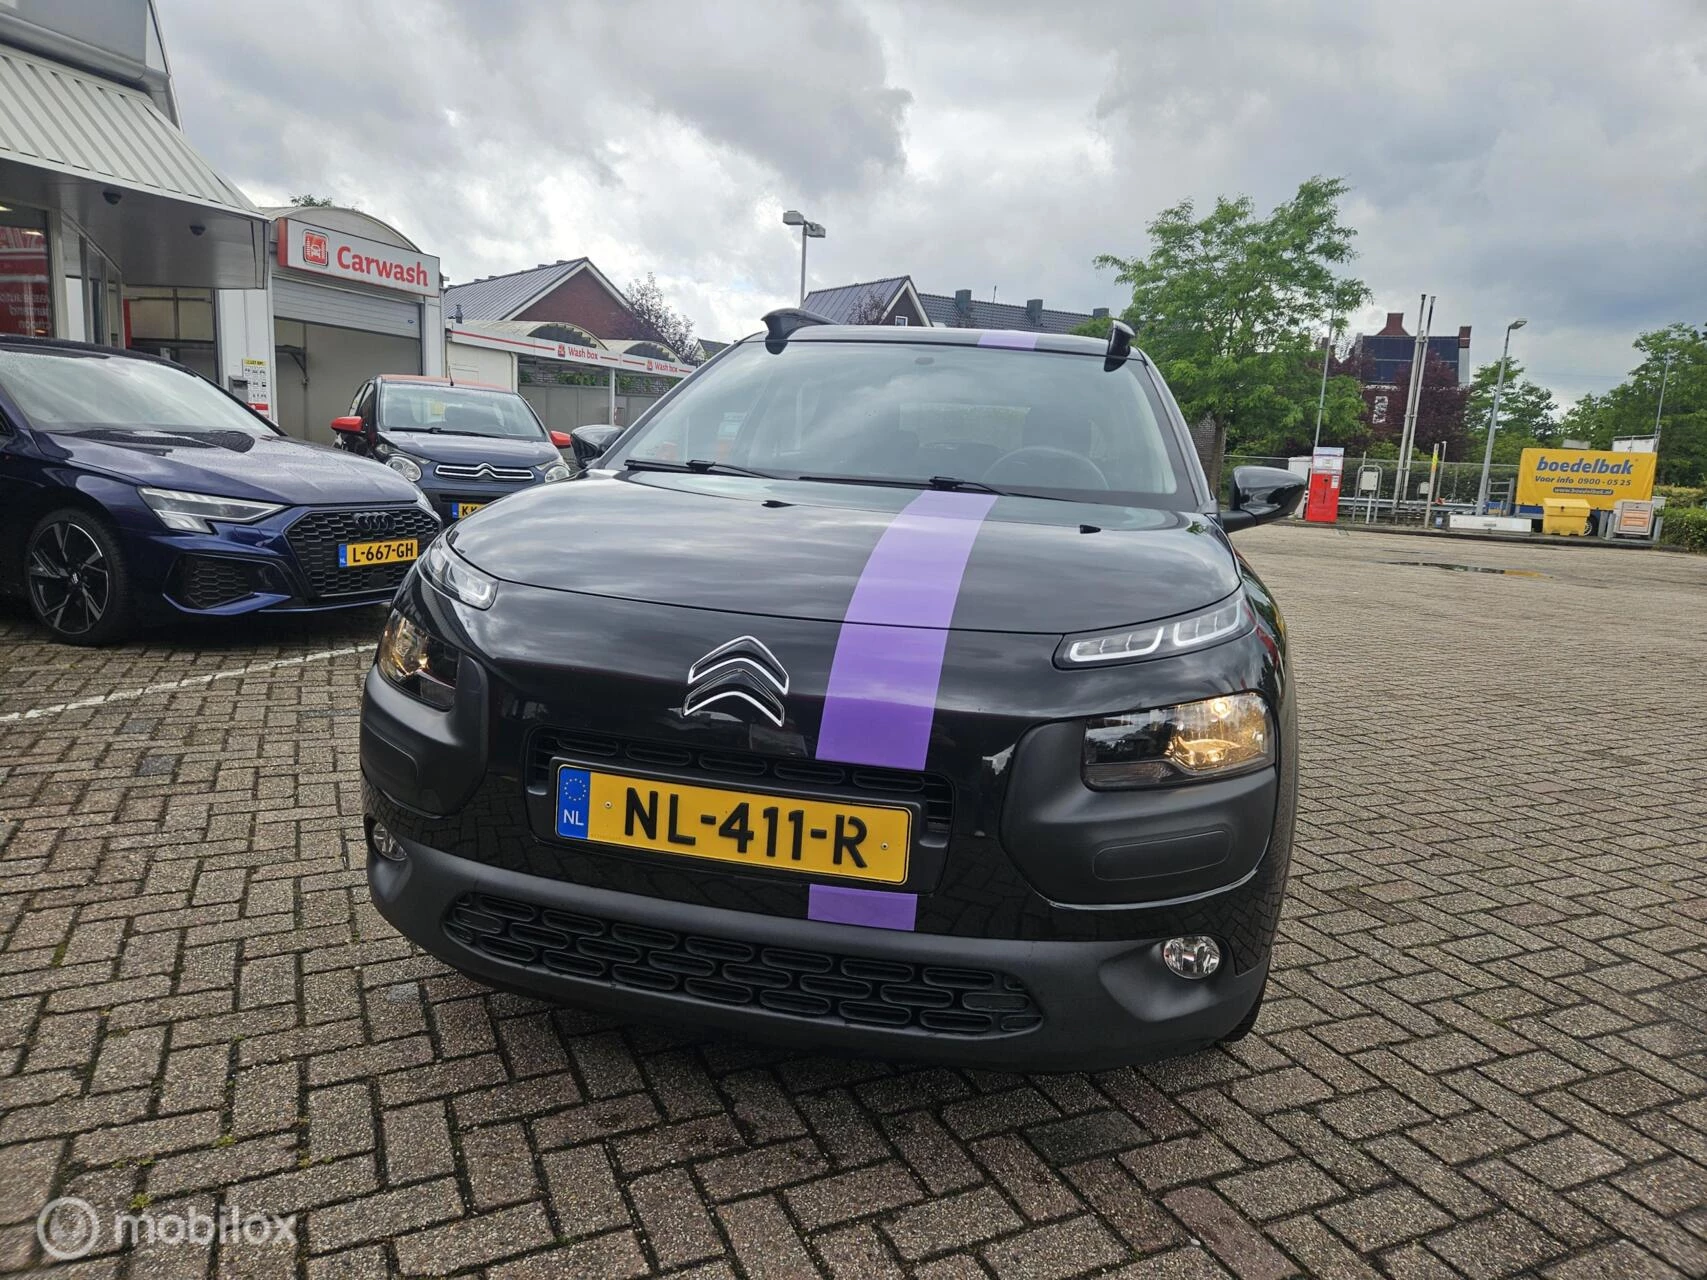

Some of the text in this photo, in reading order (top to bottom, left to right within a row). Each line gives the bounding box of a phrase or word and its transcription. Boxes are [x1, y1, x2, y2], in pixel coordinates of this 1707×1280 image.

[337, 246, 428, 286] Carwash
[568, 347, 598, 360] Wash box
[655, 362, 668, 371] Wash
[1536, 455, 1634, 474] boedelbak
[1535, 475, 1555, 483] Voor
[1556, 476, 1574, 484] info
[352, 543, 413, 563] L-667-GH
[563, 787, 867, 868] NL NL-411-R
